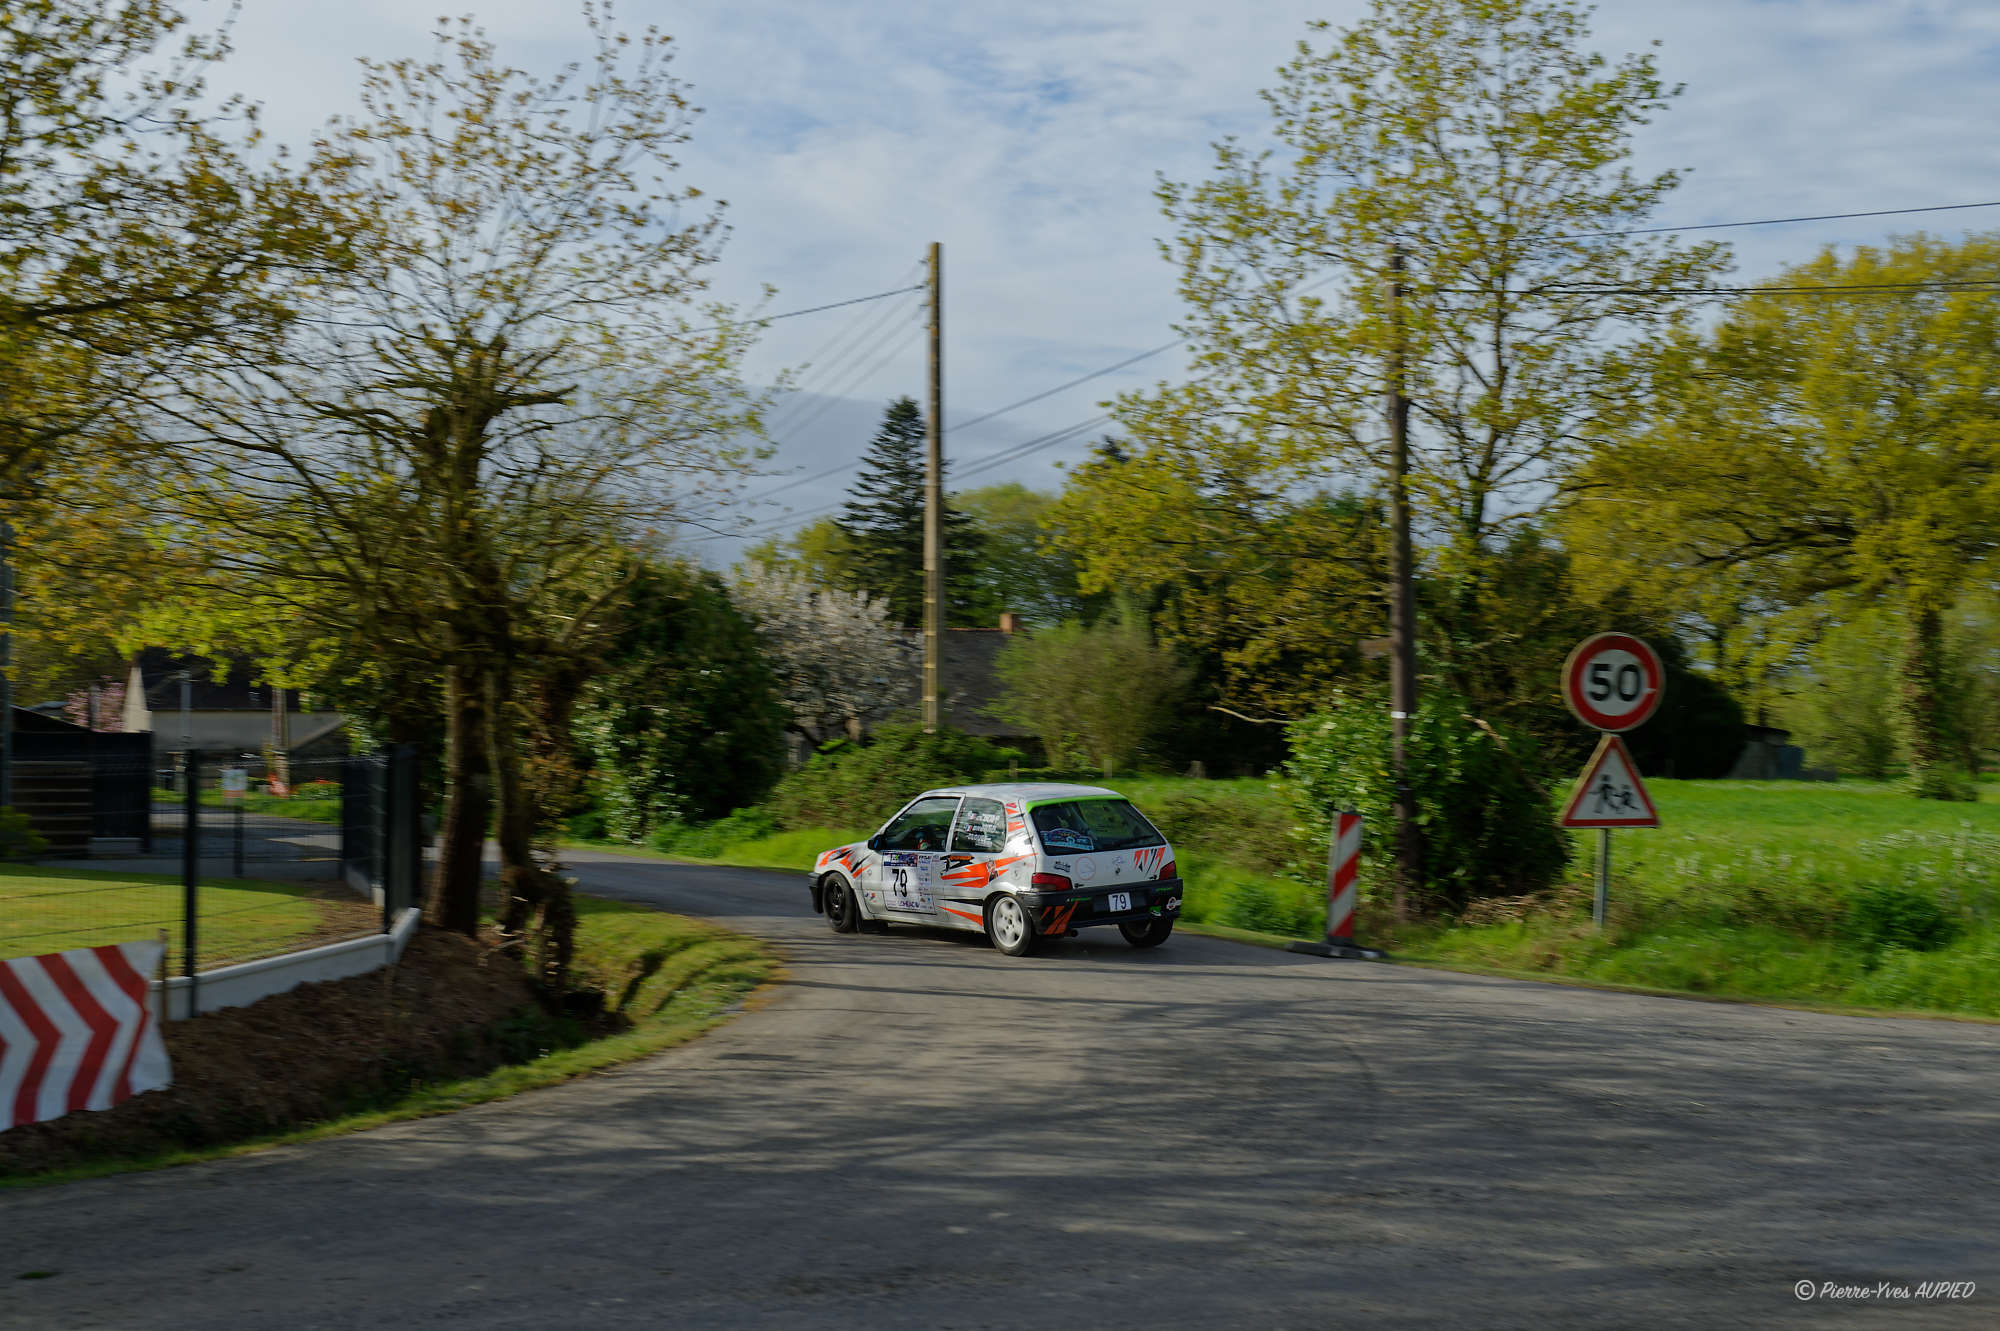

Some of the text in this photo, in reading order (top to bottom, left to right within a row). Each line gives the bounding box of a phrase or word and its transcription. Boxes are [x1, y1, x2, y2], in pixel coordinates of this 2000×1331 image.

[1591, 664, 1641, 702] 50
[891, 868, 908, 898] 79
[1112, 894, 1127, 911] 79
